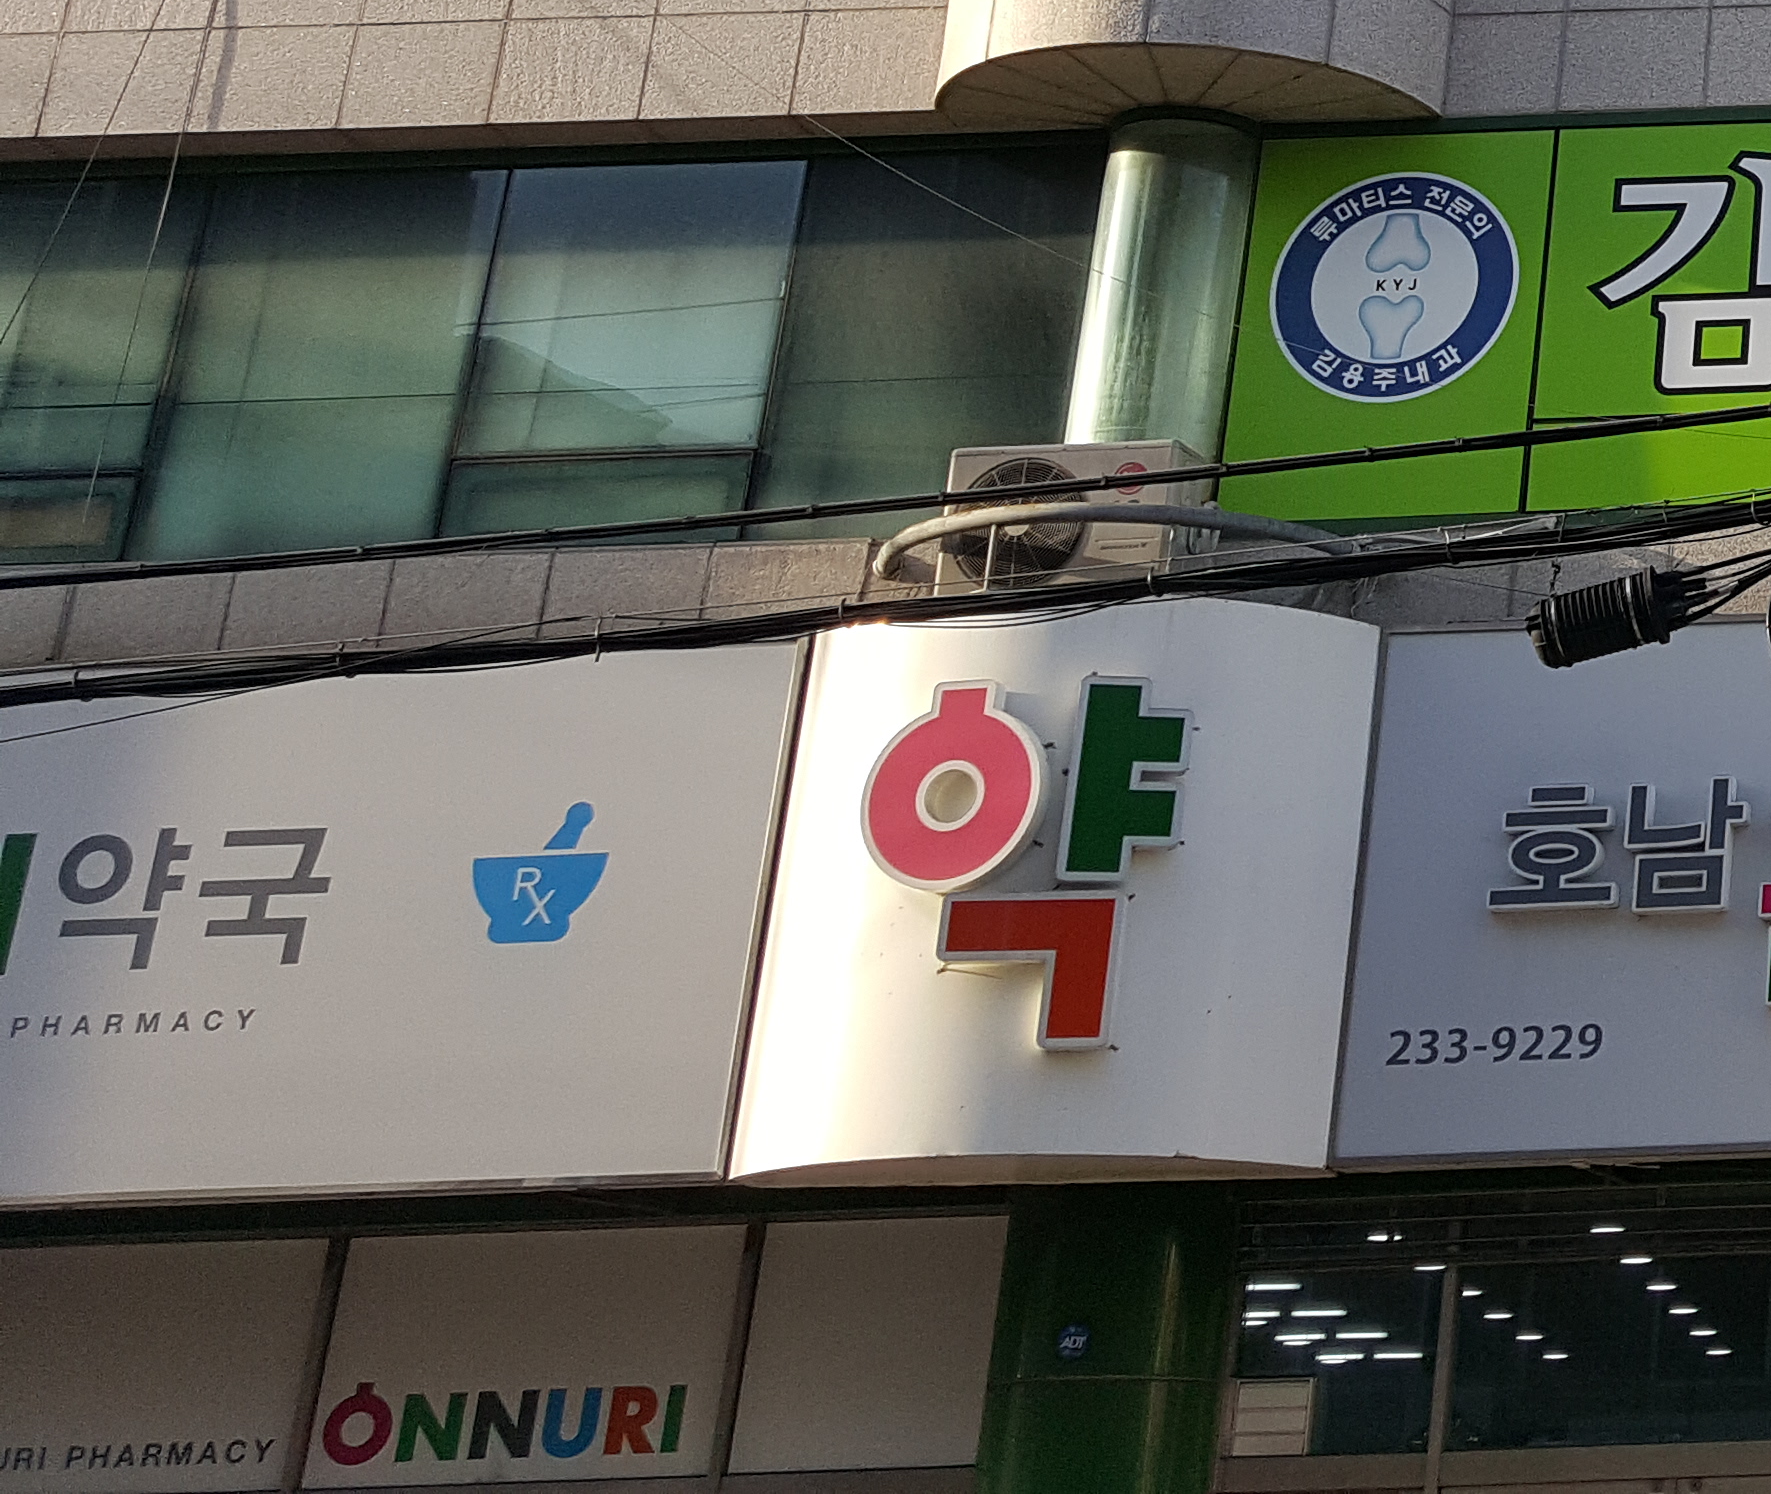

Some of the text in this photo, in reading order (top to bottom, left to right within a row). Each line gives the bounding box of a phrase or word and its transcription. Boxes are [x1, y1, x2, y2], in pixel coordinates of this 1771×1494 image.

[1310, 183, 1493, 243] 류마티스 전문의
[1312, 344, 1463, 393] 김용주내과
[860, 675, 1195, 1051] 약
[10, 1006, 258, 1040] PHARMACY
[1385, 1022, 1604, 1067] 233-9229
[1059, 1335, 1087, 1350] ADT
[320, 1381, 688, 1466] ONNURI
[65, 1437, 276, 1470] PHARMACY
